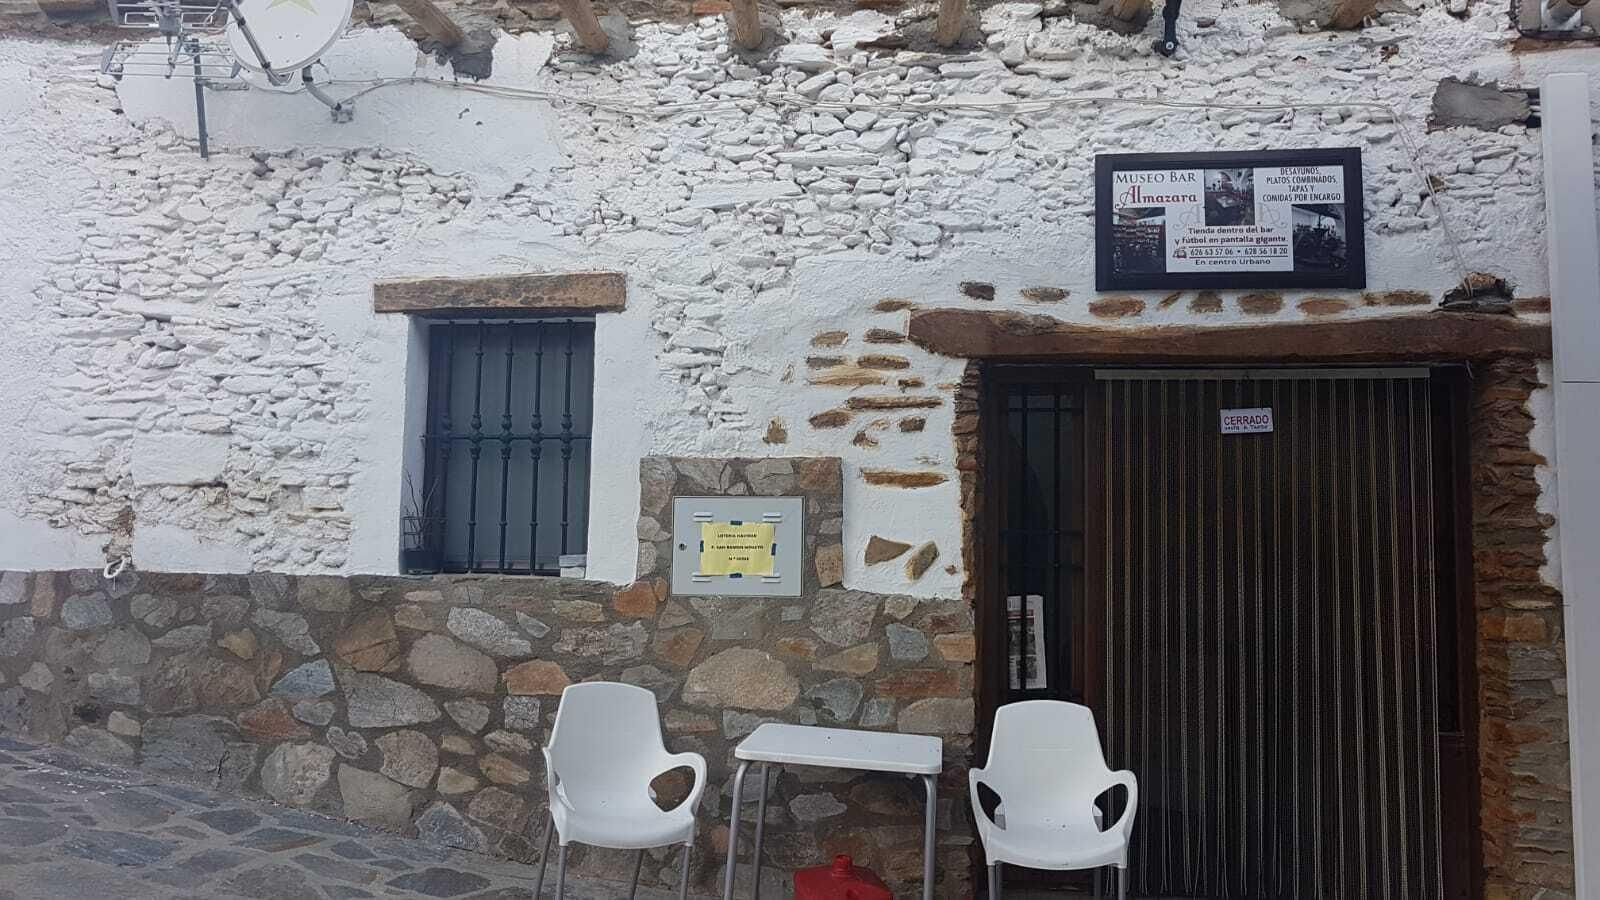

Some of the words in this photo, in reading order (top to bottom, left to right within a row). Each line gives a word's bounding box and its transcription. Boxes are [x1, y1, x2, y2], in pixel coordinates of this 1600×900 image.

[1115, 173, 1165, 184] MUSEO
[1170, 171, 1197, 182] BAR
[1266, 176, 1290, 184] PLATOS
[1288, 184, 1308, 192] TAPAS
[1310, 184, 1315, 192] Y
[1114, 185, 1198, 209] Almazara
[1262, 193, 1292, 202] COMIDAS
[1294, 193, 1308, 201] POR
[1310, 192, 1341, 201] ENCARGO
[1220, 236, 1254, 244] pantalla
[1190, 248, 1203, 256] 626
[1205, 247, 1213, 255] 63
[1215, 247, 1223, 255] 57
[1225, 247, 1233, 255] 06
[1223, 415, 1269, 425] CERRADO
